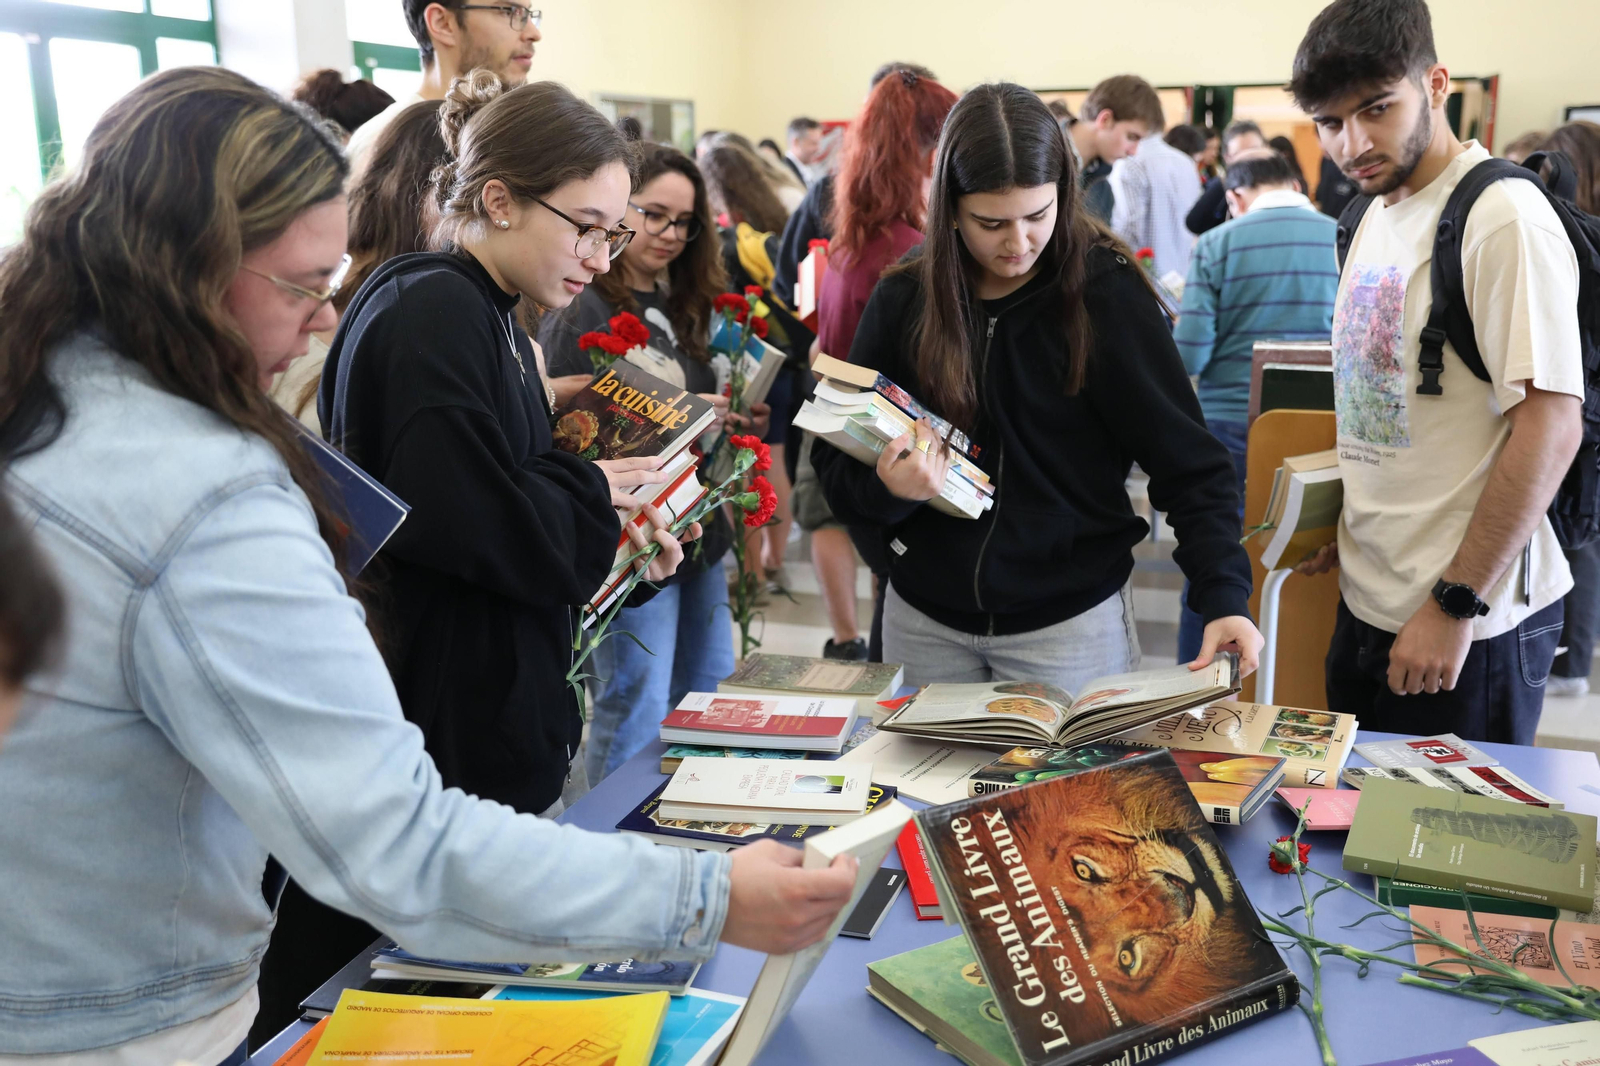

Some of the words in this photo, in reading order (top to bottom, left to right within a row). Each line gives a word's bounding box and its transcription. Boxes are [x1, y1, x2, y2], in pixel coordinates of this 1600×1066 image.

[591, 368, 617, 397] la
[612, 385, 690, 431] cuisine
[1340, 450, 1363, 461] Claude
[950, 816, 1000, 900] Livre
[982, 807, 1065, 951] Animaux
[1516, 890, 1542, 899] documento
[1051, 884, 1070, 917] DIGEST
[979, 907, 1046, 1008] Grand
[1067, 919, 1091, 962] READER'S
[1571, 940, 1586, 959] Vino
[1056, 954, 1086, 1005] des
[1086, 962, 1098, 978] DU
[1573, 960, 1590, 970] El
[346, 1004, 373, 1012] MADRID
[383, 1007, 425, 1015] ARQUITECTOS
[1041, 1009, 1071, 1054] Le
[1133, 1037, 1174, 1064] Livre
[1178, 1023, 1204, 1045] des
[1207, 998, 1270, 1034] Animaux
